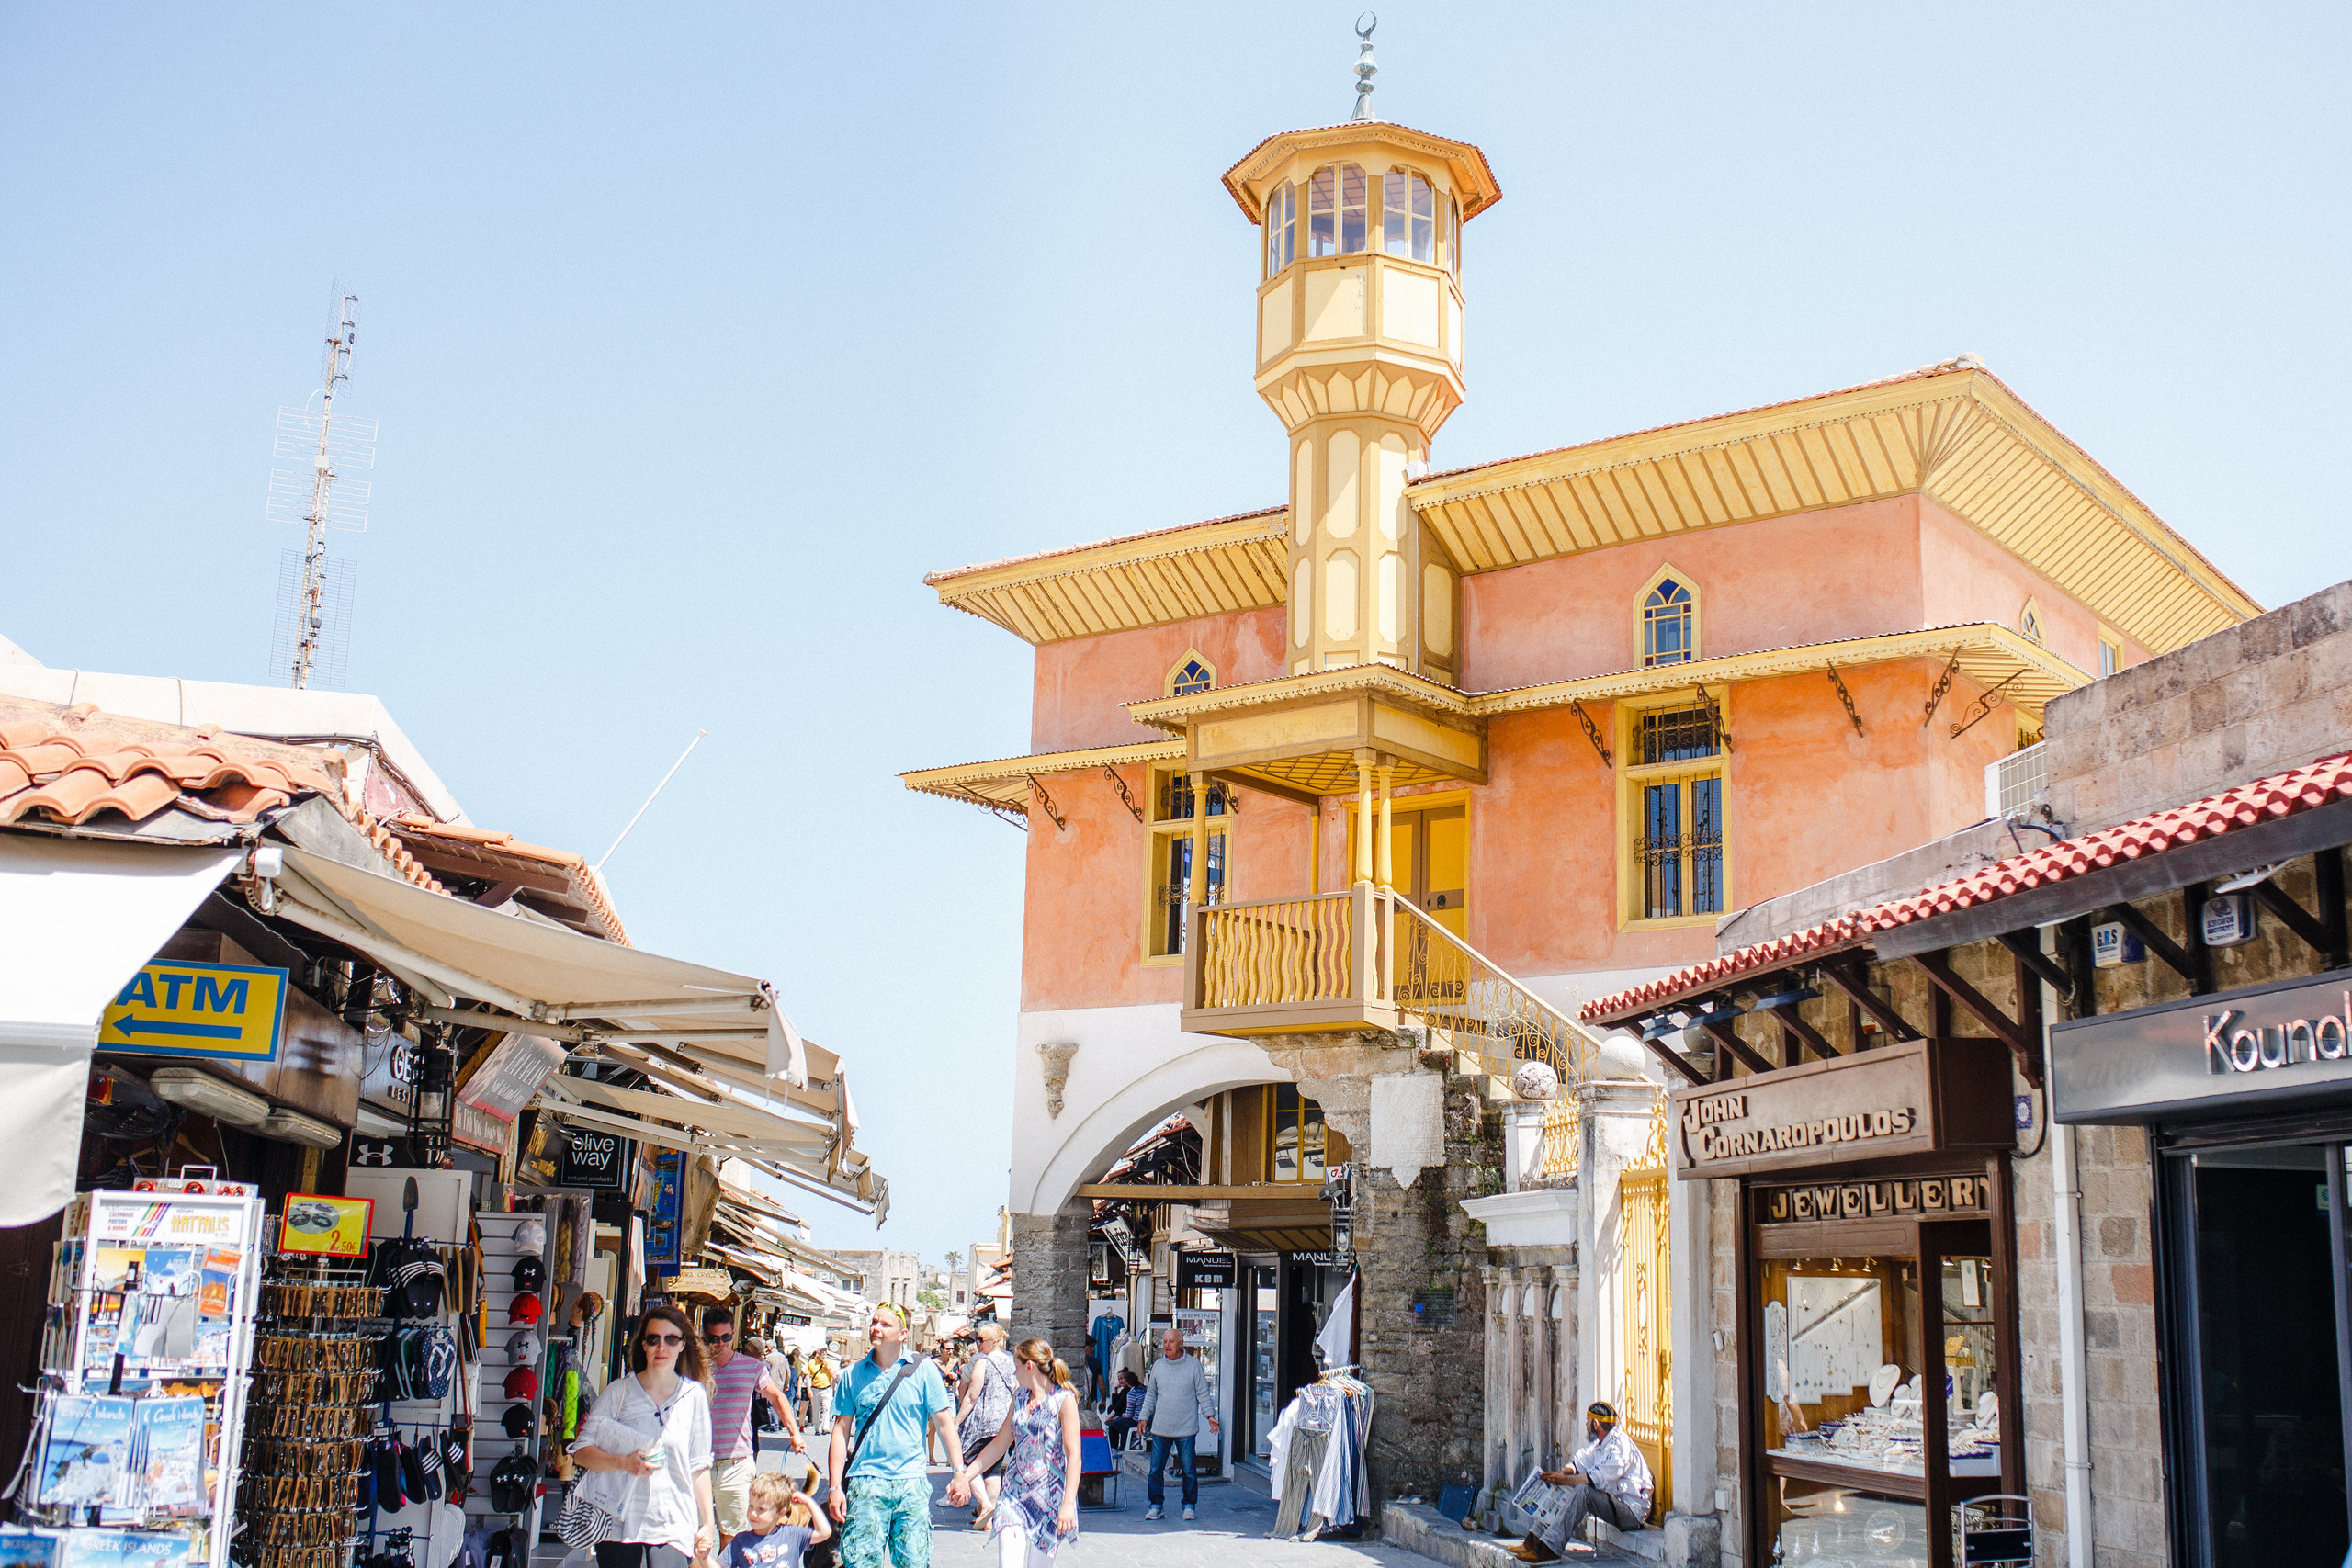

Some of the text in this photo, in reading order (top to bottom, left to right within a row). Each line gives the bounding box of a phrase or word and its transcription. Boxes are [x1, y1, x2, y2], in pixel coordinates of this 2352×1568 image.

[115, 972, 249, 1015] ATM
[1682, 1095, 1746, 1134] JOHN
[571, 1133, 615, 1152] olive
[1699, 1107, 1913, 1160] CORNAROPOULOS
[571, 1151, 612, 1171] way
[1186, 1257, 1232, 1267] MANUEL
